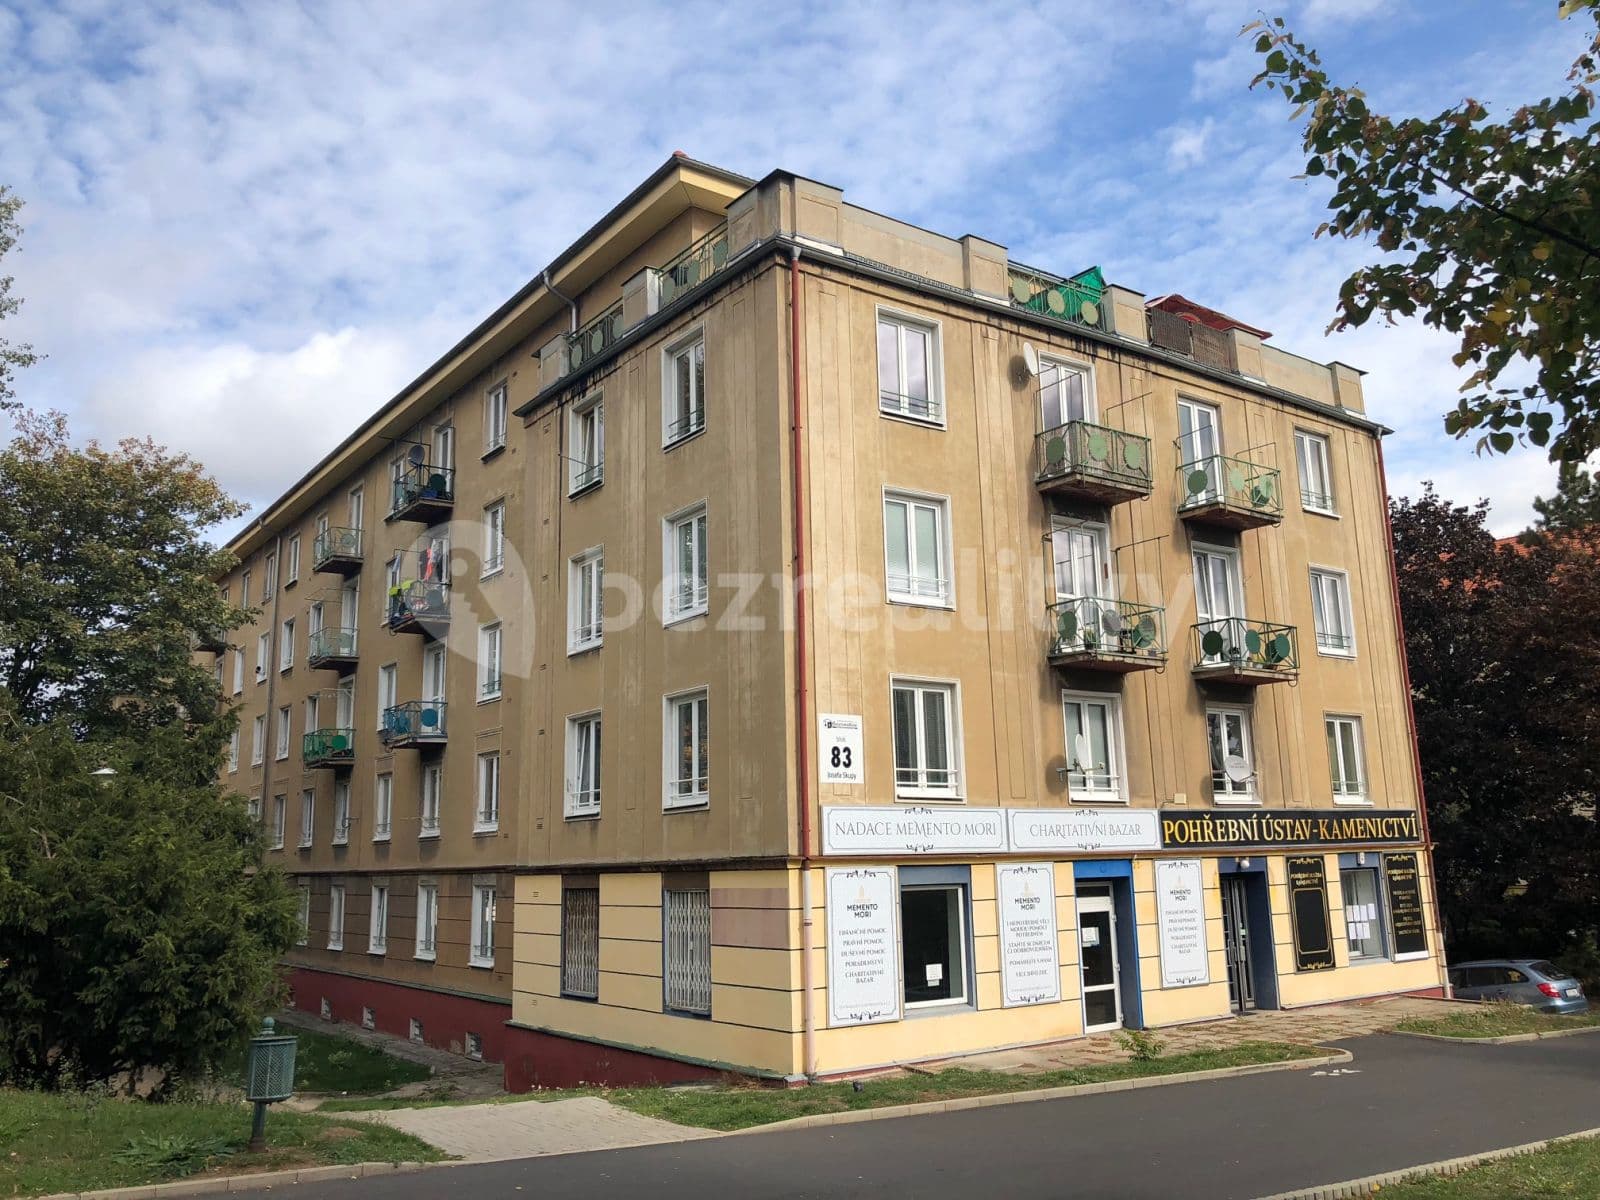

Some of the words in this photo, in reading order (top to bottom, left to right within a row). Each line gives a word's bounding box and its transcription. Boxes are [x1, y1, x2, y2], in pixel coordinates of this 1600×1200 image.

[831, 745, 852, 768] 83
[835, 821, 893, 836] NADACE
[896, 820, 961, 838] MEMENTO
[964, 822, 996, 836] MORI
[1029, 820, 1106, 839] CHARITATIVNÍ
[1109, 823, 1141, 836] BAZAR
[1162, 813, 1258, 844] POHŘEBNÍ
[847, 903, 878, 911] MEMENTO
[1014, 897, 1041, 905] MEMENTO
